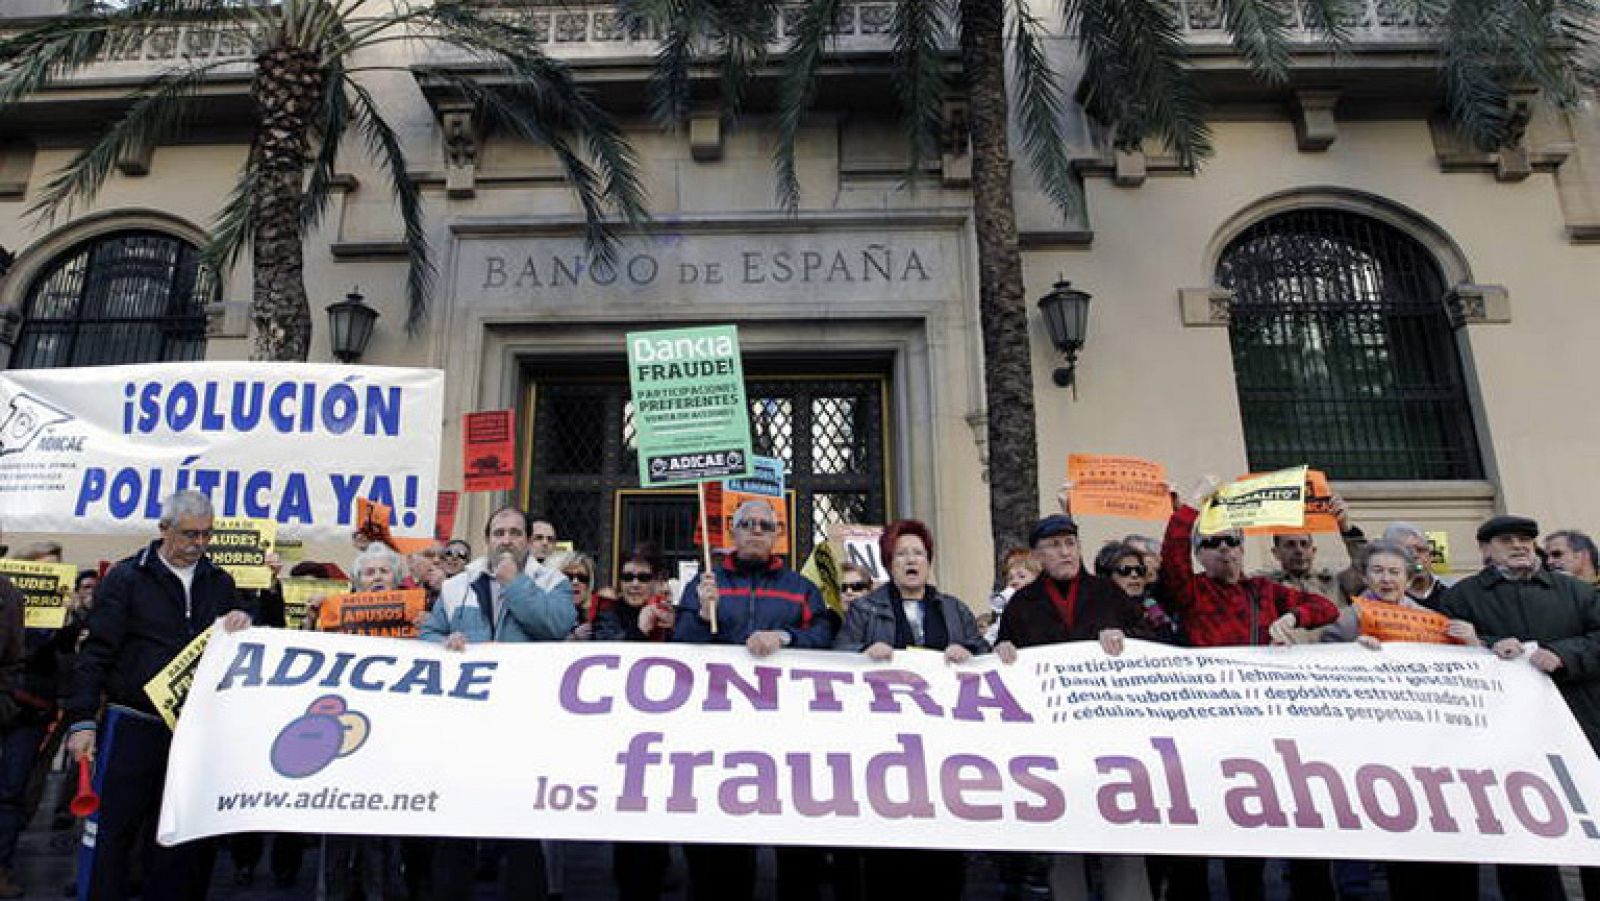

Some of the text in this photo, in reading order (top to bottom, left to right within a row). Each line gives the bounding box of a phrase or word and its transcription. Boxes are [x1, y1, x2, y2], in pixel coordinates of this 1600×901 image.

[482, 244, 930, 289] BANCO DE ESPAÑA
[634, 335, 732, 361] Bankia
[637, 358, 734, 381] FRAUDE!
[637, 384, 738, 399] PARTICIPACIONES
[638, 394, 739, 412] PREFERENTES
[124, 375, 402, 436] ¡SOLUCIÓN
[670, 454, 724, 471] ADICAE
[74, 455, 313, 524] POLÍTICA
[328, 473, 419, 528] YA!
[216, 642, 498, 701] ADICAE
[1054, 655, 1193, 674] participaciones
[559, 654, 1033, 723] CONTRA
[1067, 690, 1124, 704] deuda
[1126, 687, 1241, 704] subordinada
[1264, 685, 1351, 702] depósitos
[1353, 687, 1469, 707] estructurados
[1073, 705, 1145, 720] cédulas
[1148, 704, 1263, 721] hipotecarias
[1287, 703, 1343, 718] deuda
[1345, 706, 1424, 722] perpetua
[533, 732, 1600, 839] los fraudes al ahorro!
[216, 786, 439, 813] www.adicae.net
